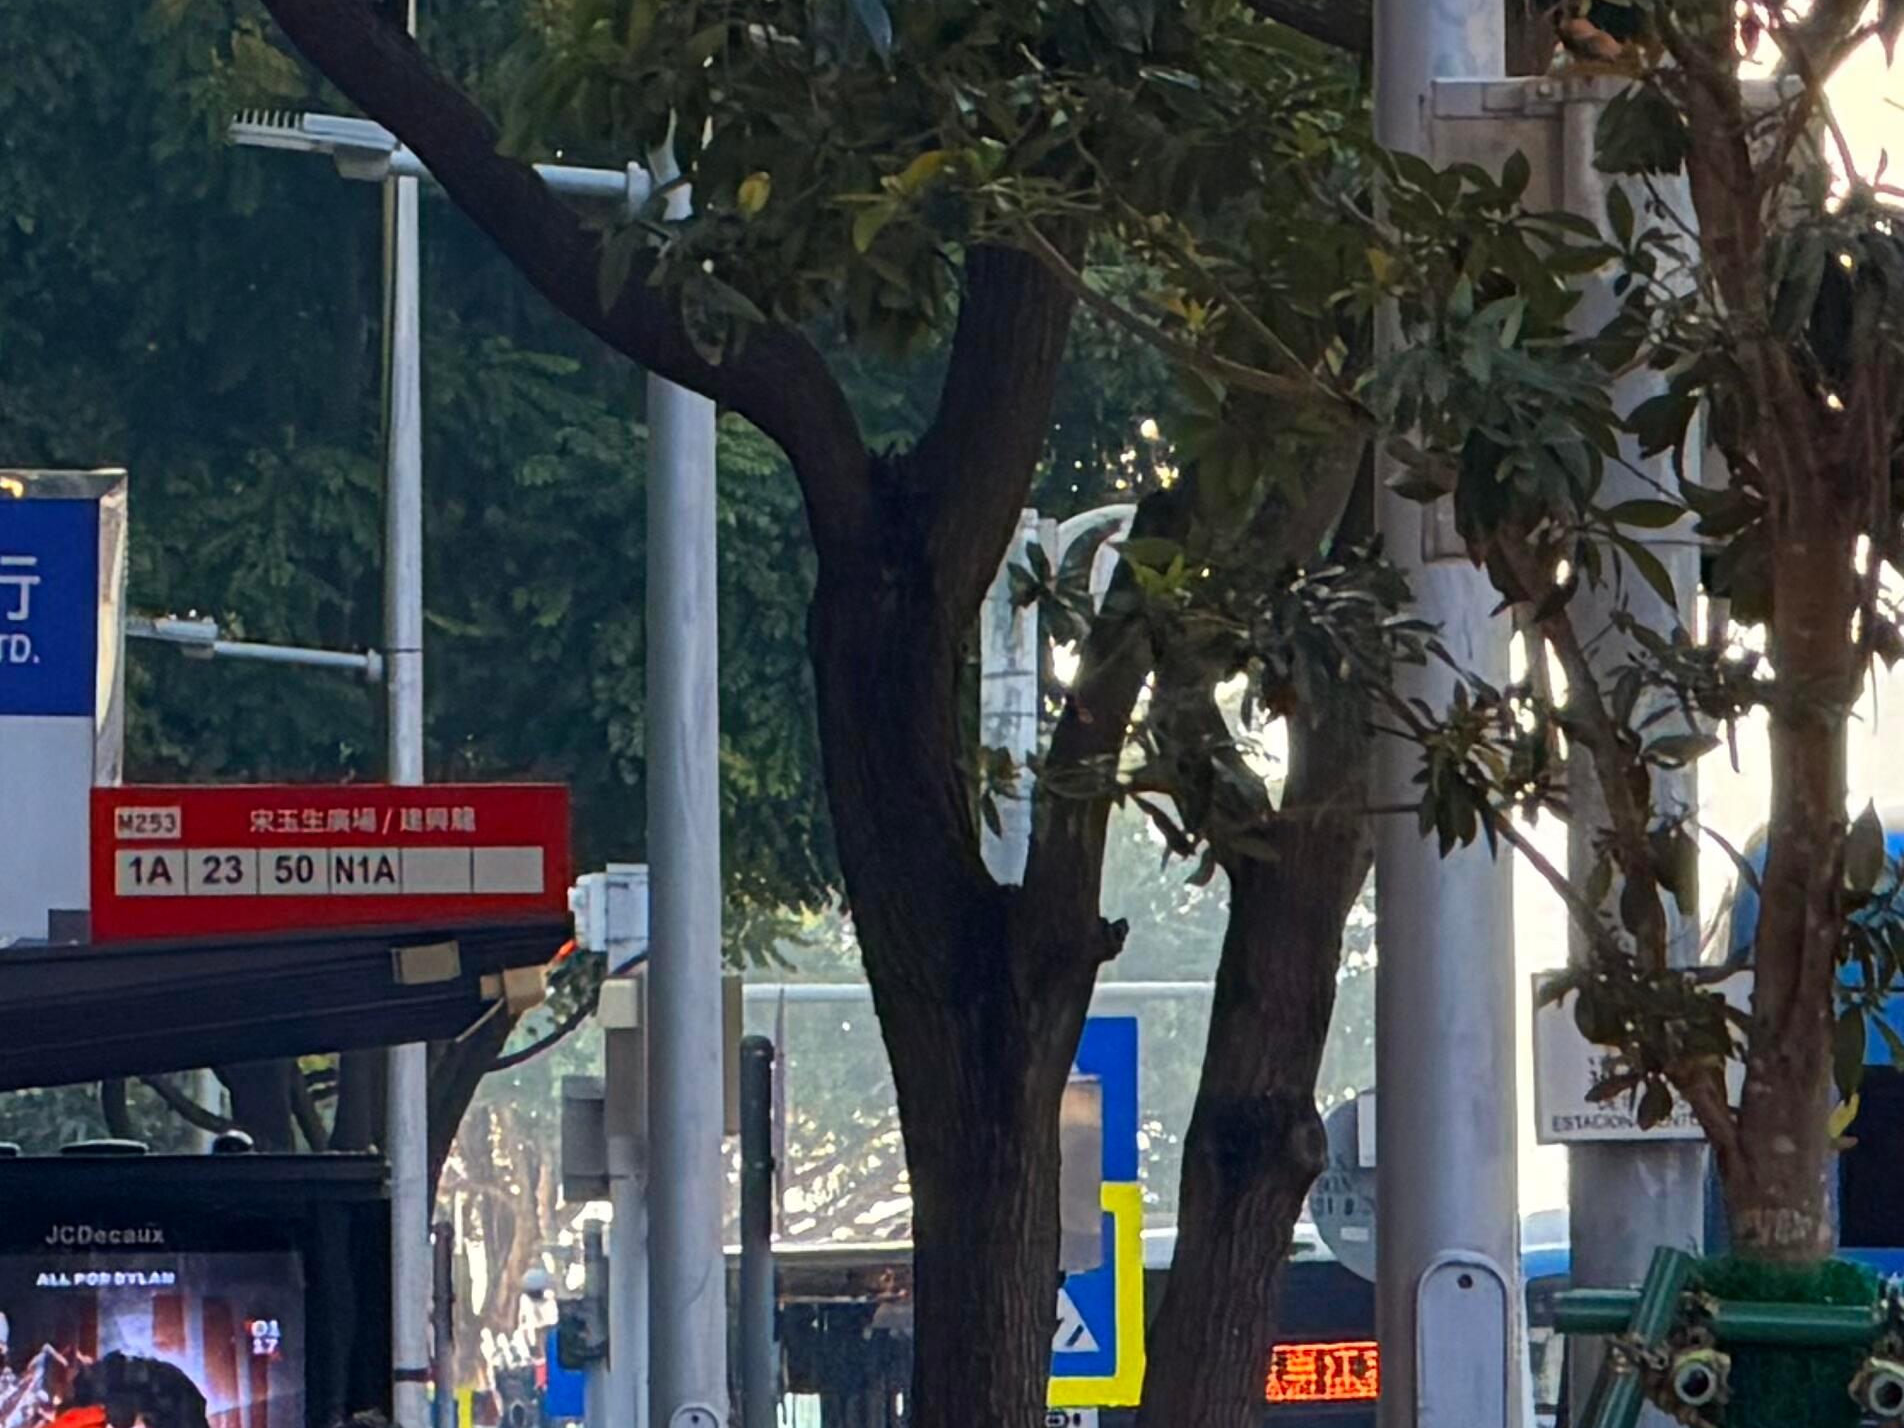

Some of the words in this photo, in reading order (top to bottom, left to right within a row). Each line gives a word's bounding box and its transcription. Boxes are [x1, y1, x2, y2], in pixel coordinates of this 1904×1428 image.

[118, 813, 177, 834] M253
[129, 855, 173, 886] 1A
[202, 854, 244, 885] 23
[274, 854, 314, 885] 50
[336, 854, 396, 885] N1A
[45, 1224, 165, 1245] JCDecaux
[36, 1272, 72, 1287] ALL
